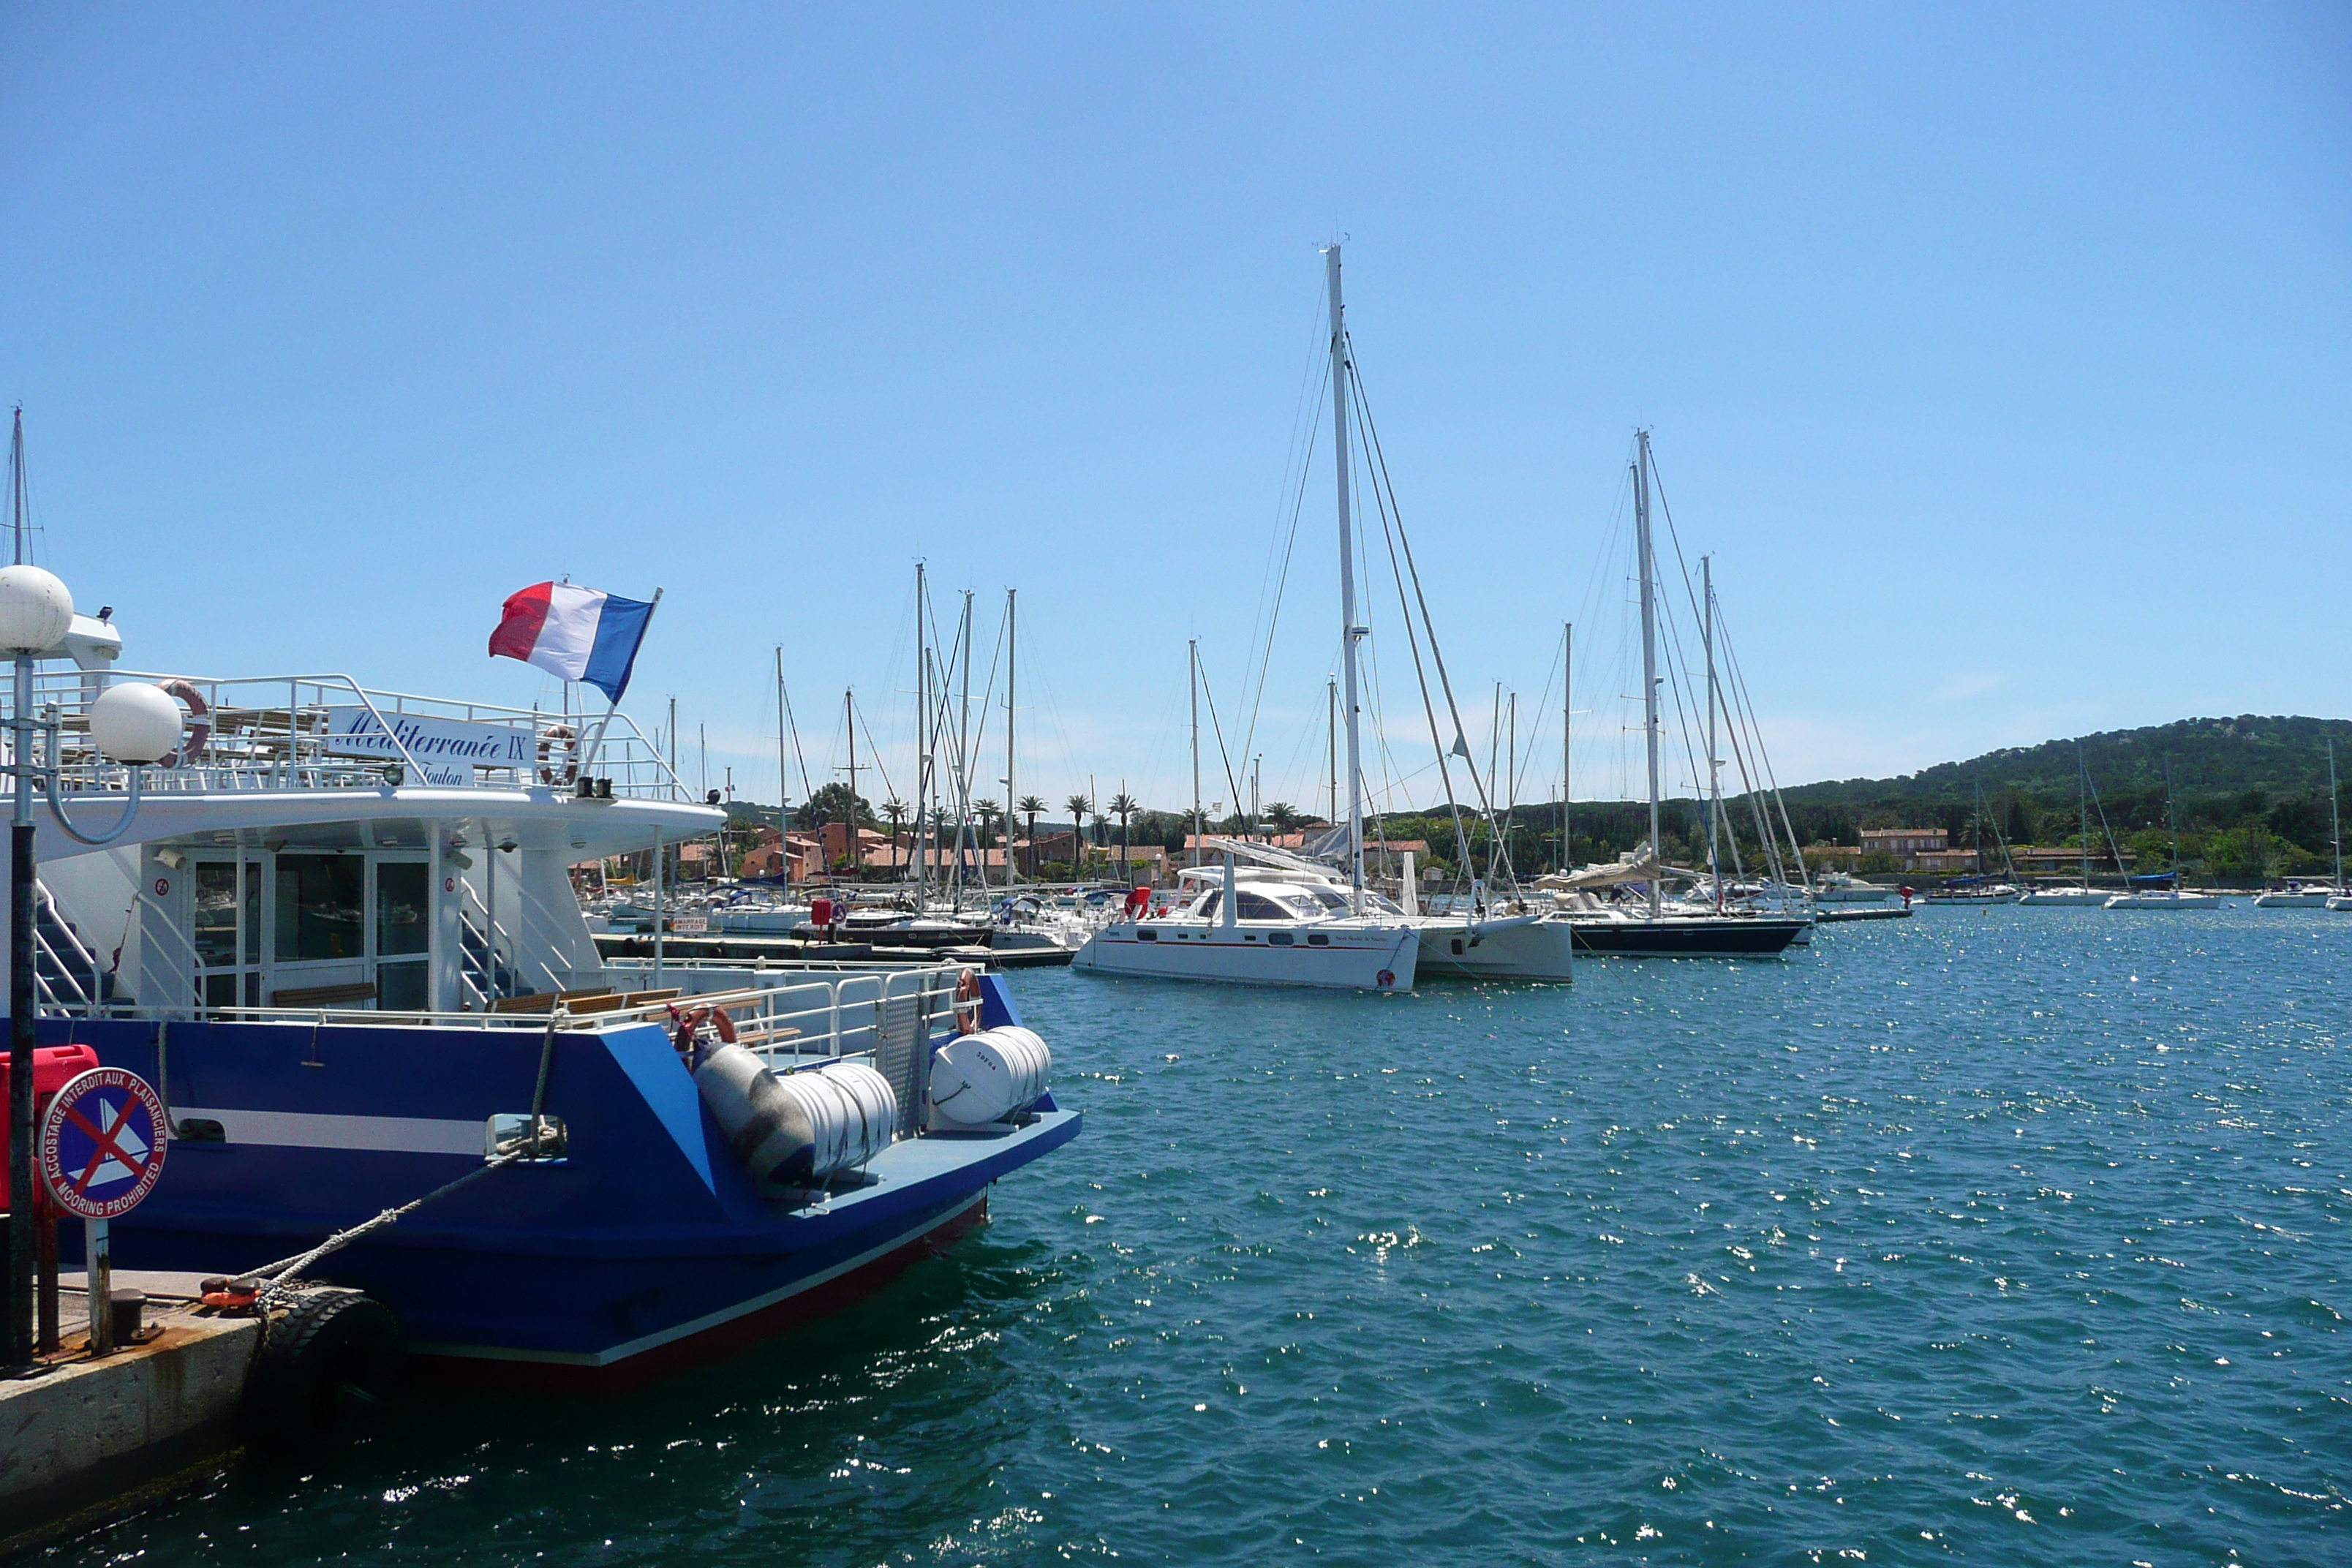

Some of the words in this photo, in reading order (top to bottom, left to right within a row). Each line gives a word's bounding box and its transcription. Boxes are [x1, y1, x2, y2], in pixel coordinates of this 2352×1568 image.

[335, 712, 501, 758] Méditerranée
[508, 736, 526, 760] IX
[415, 761, 462, 785] Toulon
[45, 1107, 67, 1179] ACCOSTAGE
[61, 1073, 103, 1108] INTERDIT
[105, 1072, 125, 1086] AUX
[129, 1078, 164, 1152] PLAISANCIERS
[57, 1182, 103, 1215] MOORING
[108, 1162, 159, 1214] PROHIBITED
